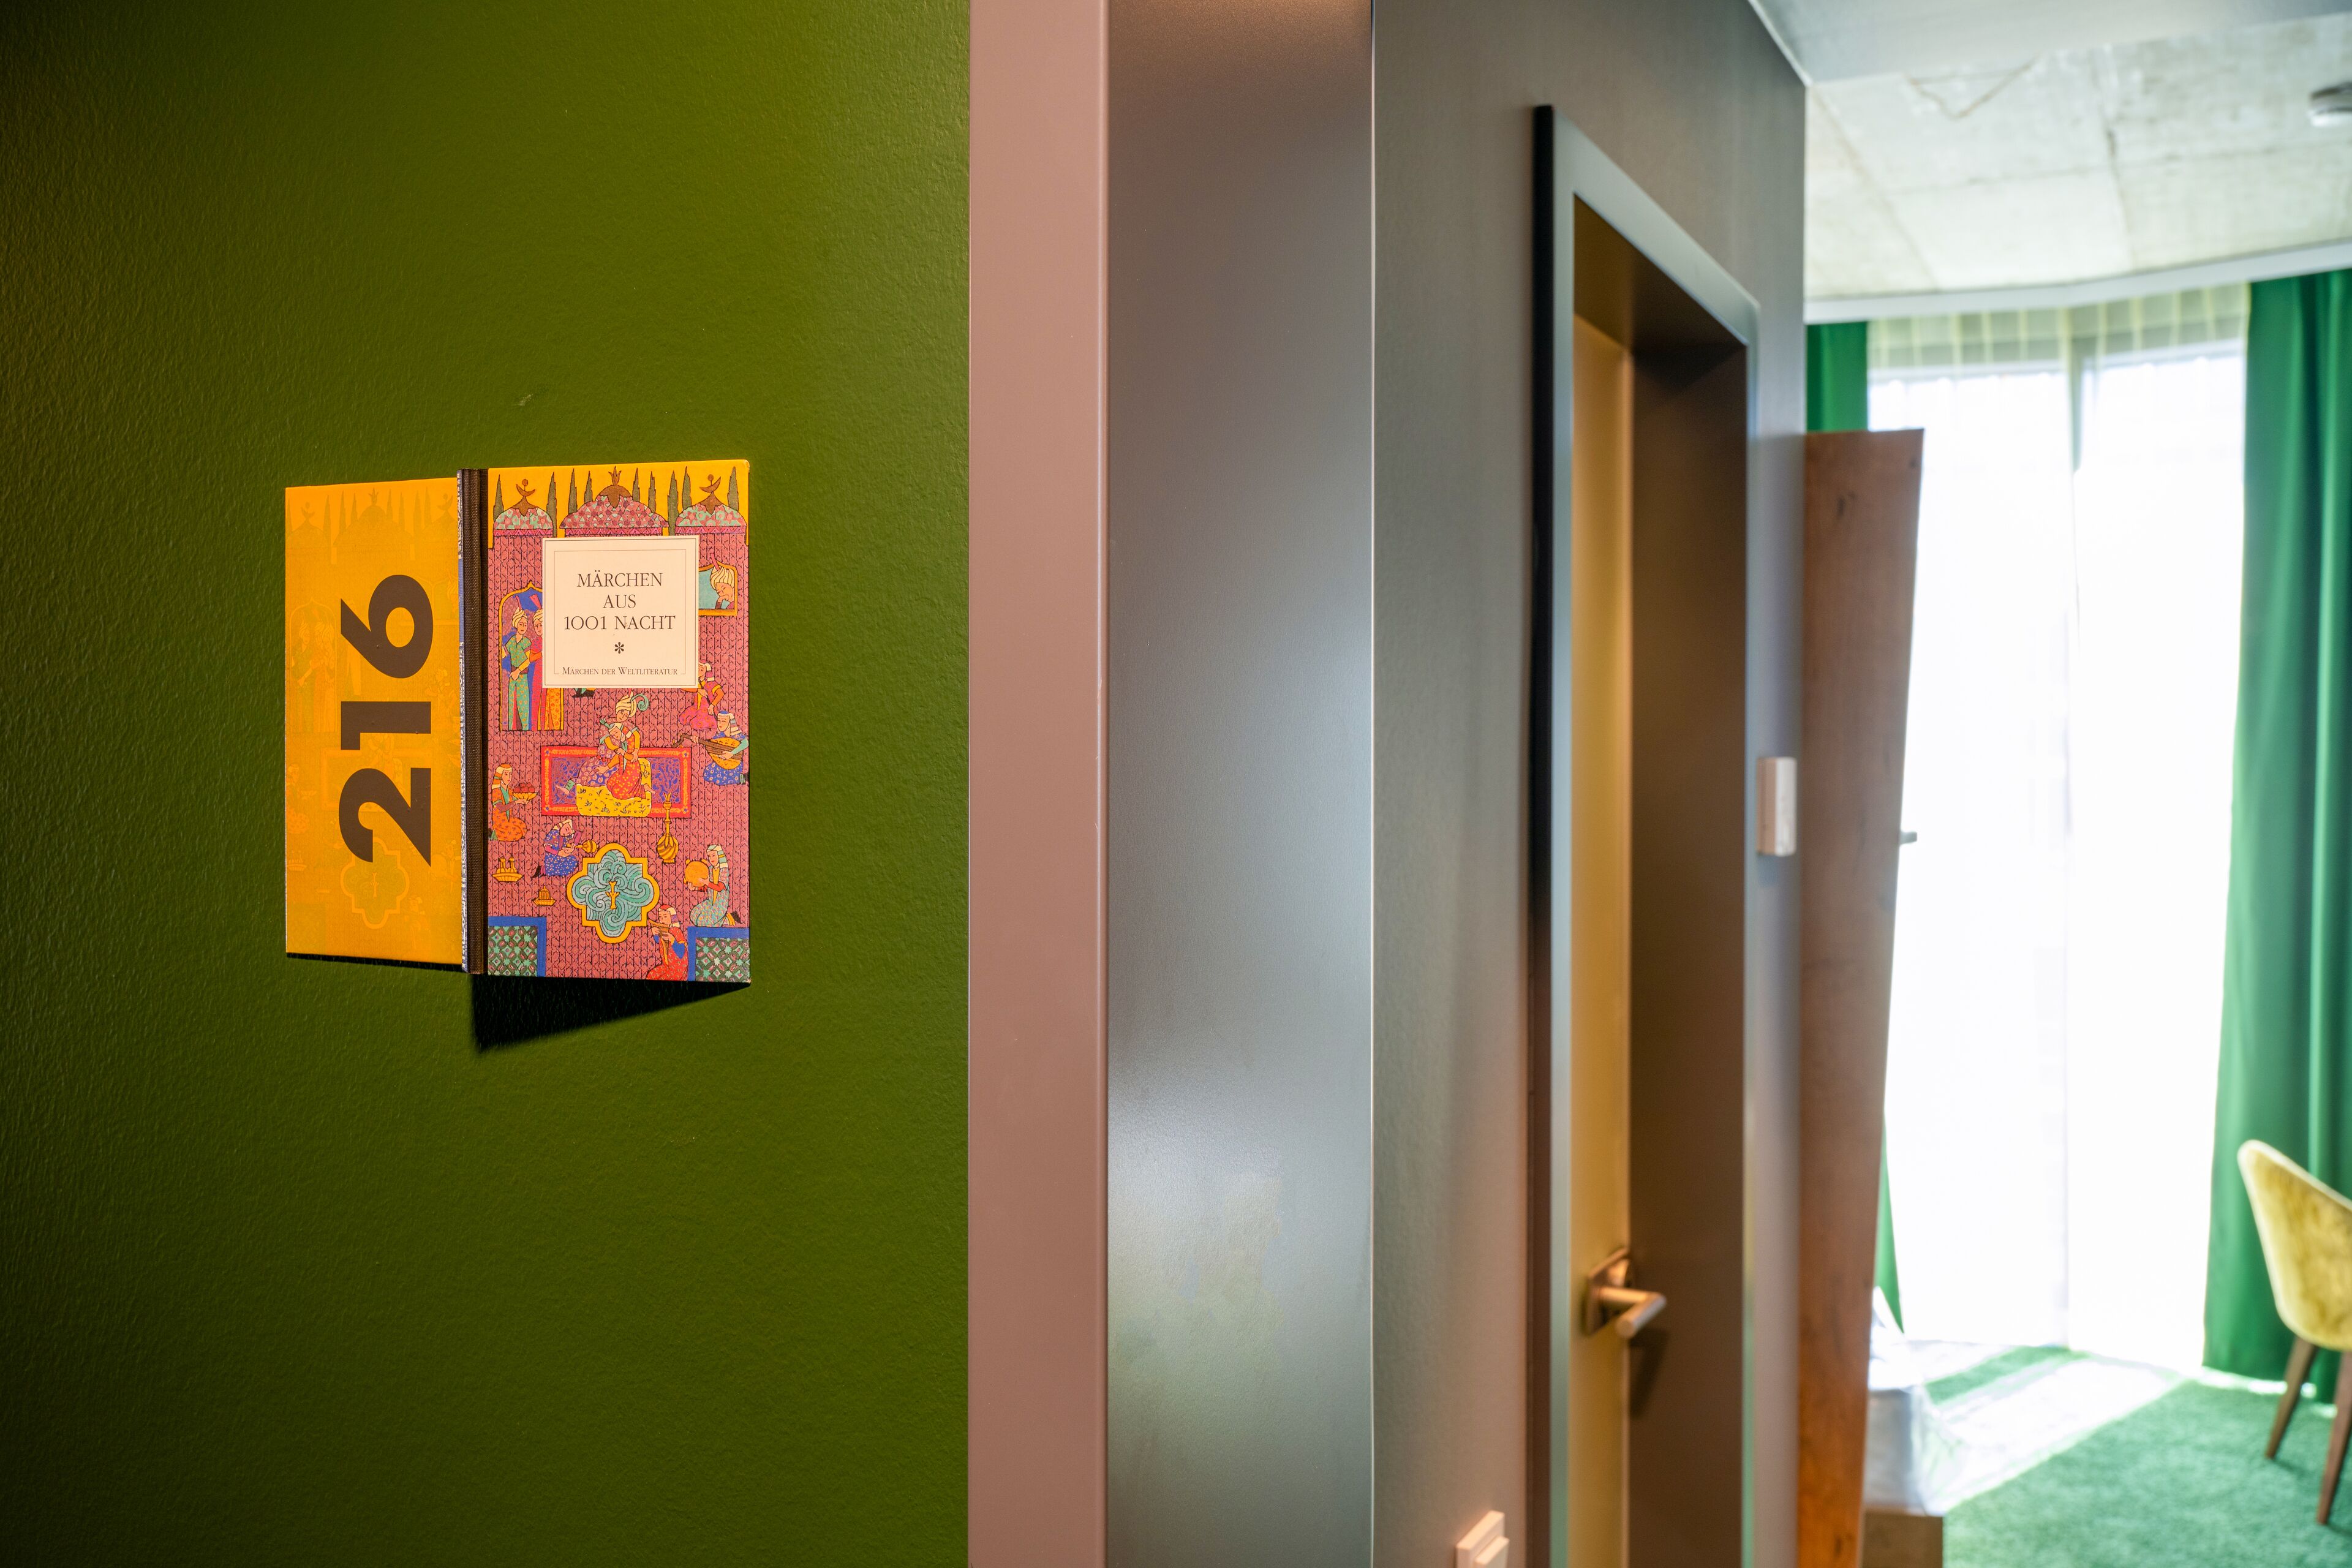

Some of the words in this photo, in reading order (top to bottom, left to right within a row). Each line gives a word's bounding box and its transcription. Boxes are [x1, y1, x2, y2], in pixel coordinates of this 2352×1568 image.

[577, 570, 663, 587] MÄRCHEN
[603, 594, 636, 608] AUS
[564, 616, 607, 630] 1001
[614, 616, 676, 630] NACHT
[339, 575, 434, 866] 216
